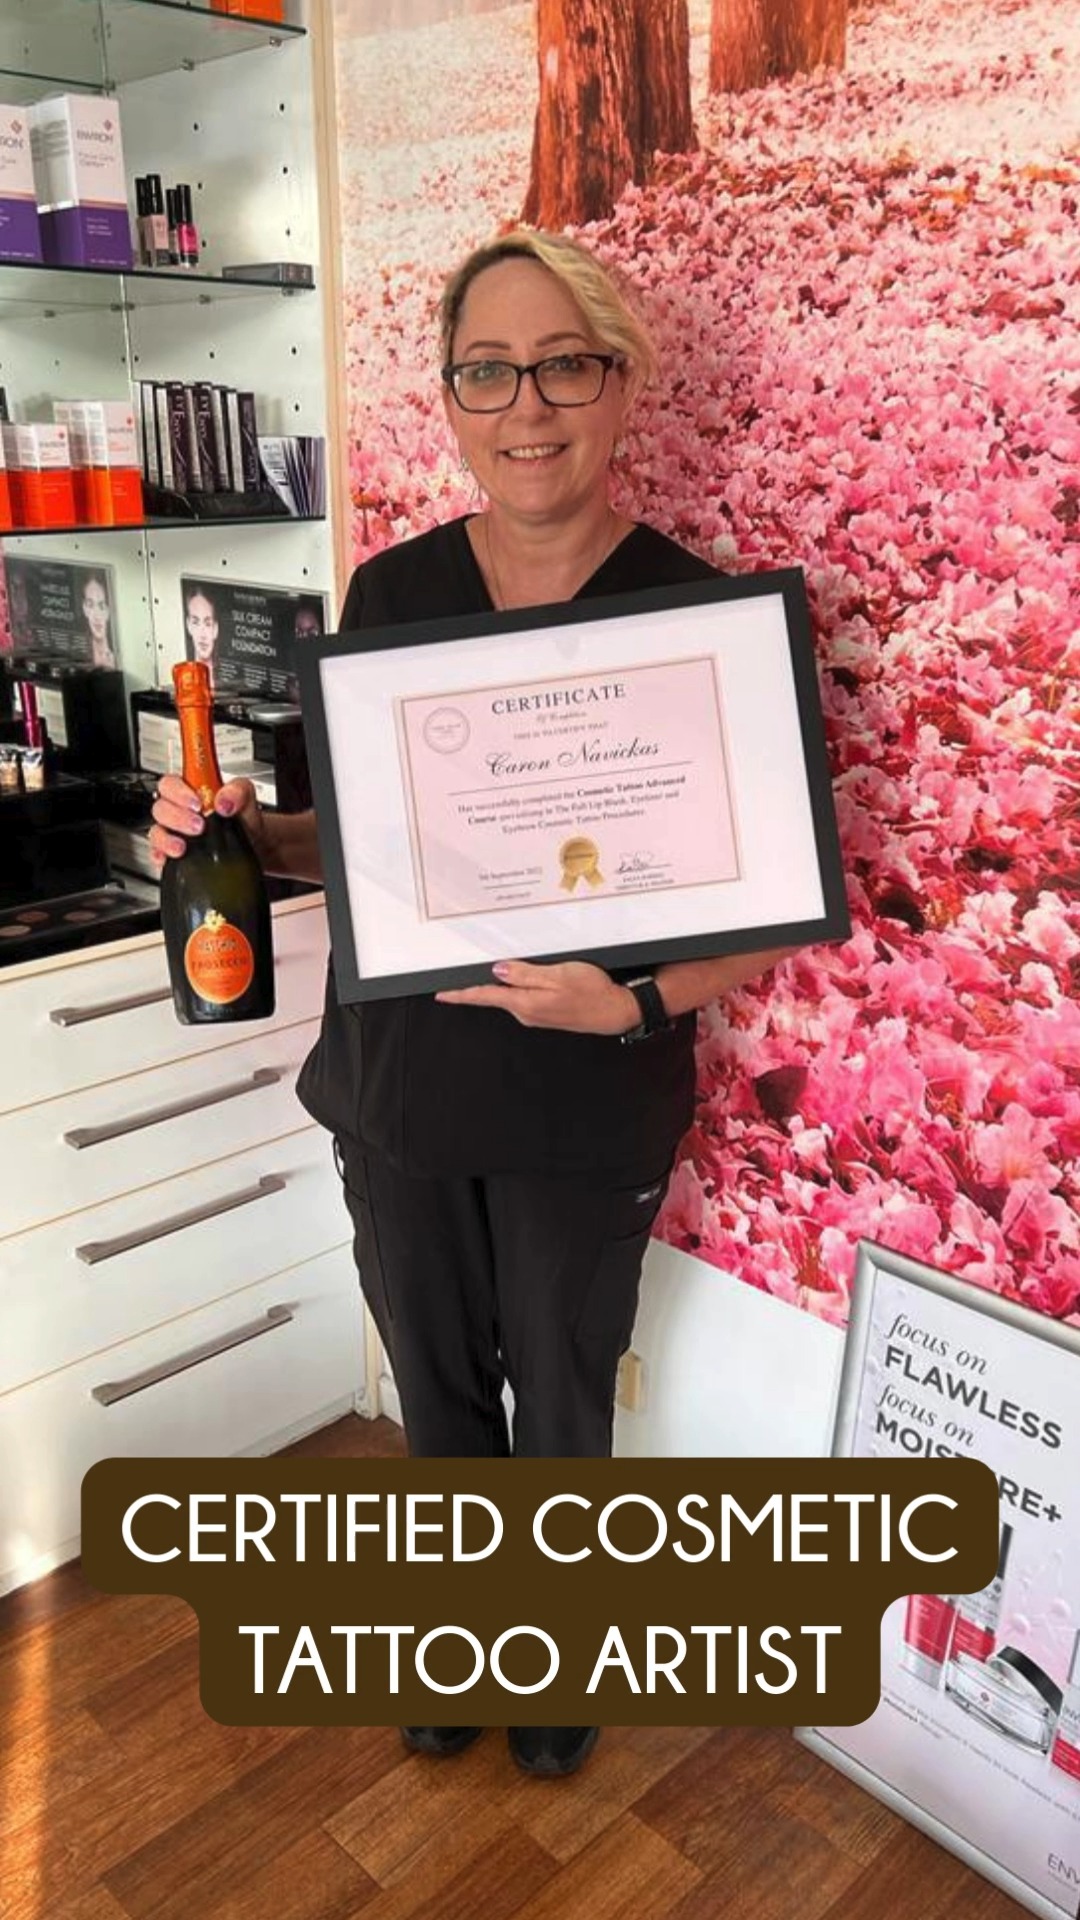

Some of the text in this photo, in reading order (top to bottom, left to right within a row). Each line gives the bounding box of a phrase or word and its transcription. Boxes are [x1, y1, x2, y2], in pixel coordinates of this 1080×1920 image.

[491, 683, 627, 716] CERTIFICATE
[485, 737, 661, 778] Caron Navickas
[885, 1313, 988, 1375] focus on
[876, 1384, 975, 1447] focus on
[884, 1345, 1062, 1450] FLAWLESS
